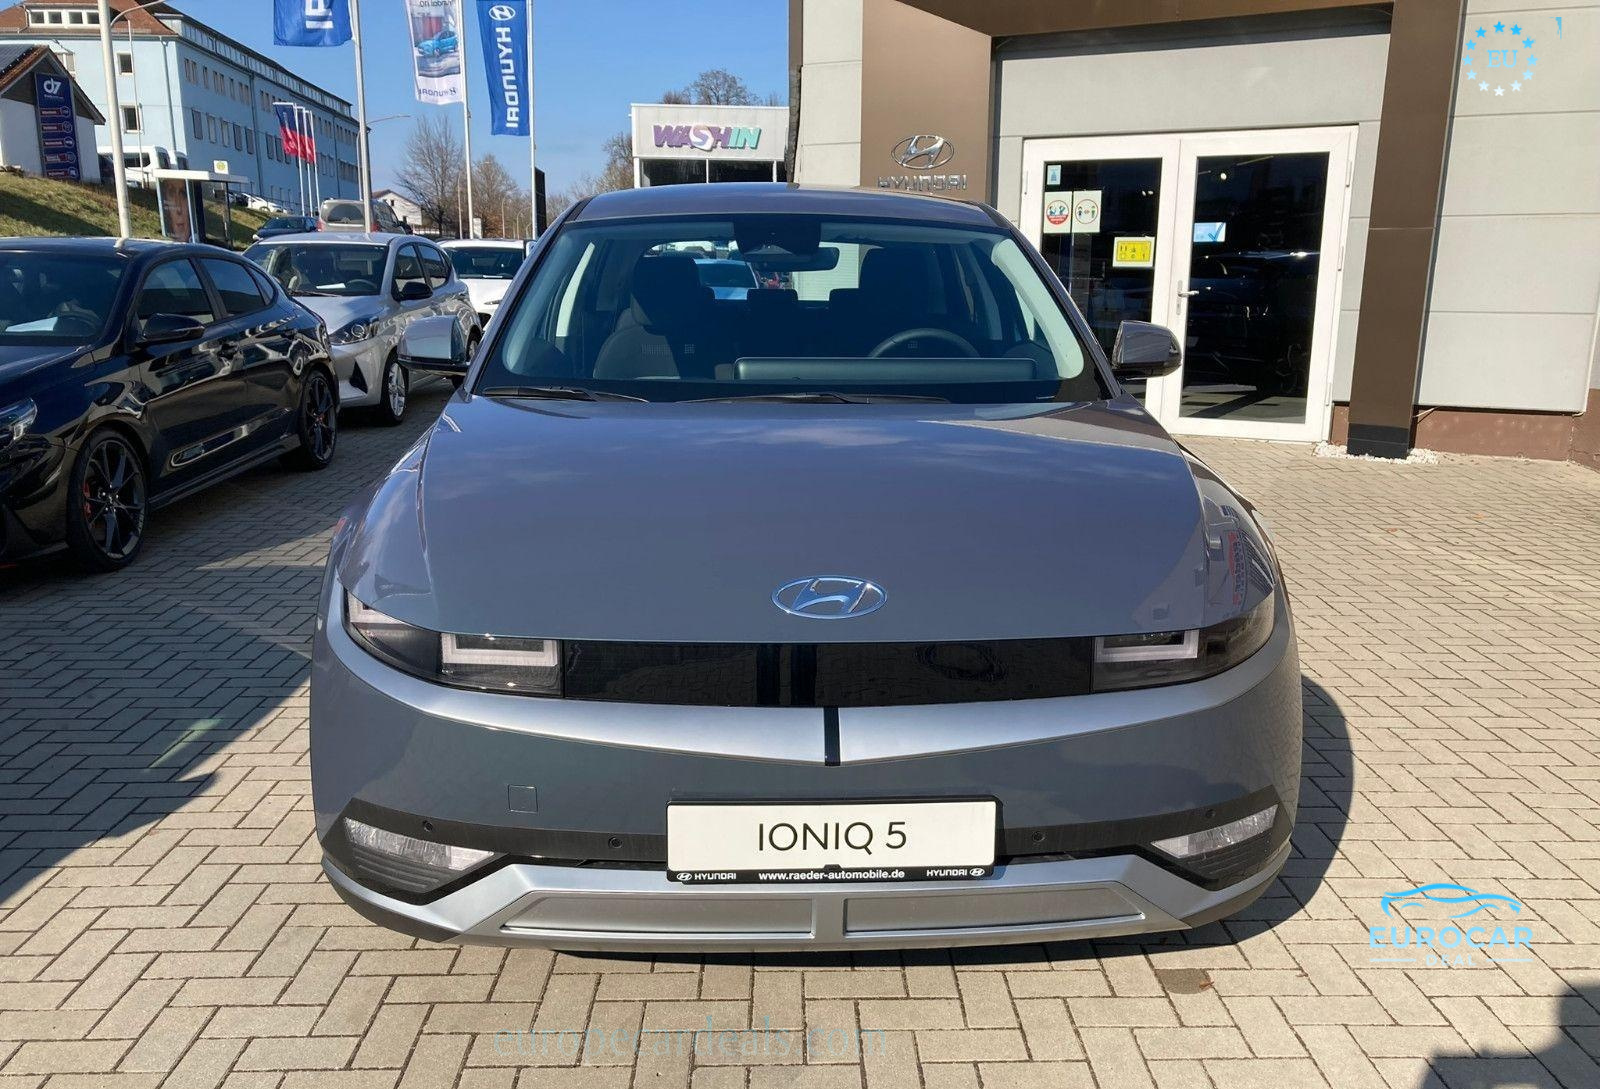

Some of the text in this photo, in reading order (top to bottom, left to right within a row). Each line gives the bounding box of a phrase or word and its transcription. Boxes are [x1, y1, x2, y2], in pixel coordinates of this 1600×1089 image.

[877, 174, 968, 191] HYUNDAI
[758, 821, 907, 855] IONIQ 5
[694, 872, 737, 880] HYUNDAI
[758, 869, 905, 881] www.raeder-automobile.de
[926, 869, 968, 877] HYUNDAI
